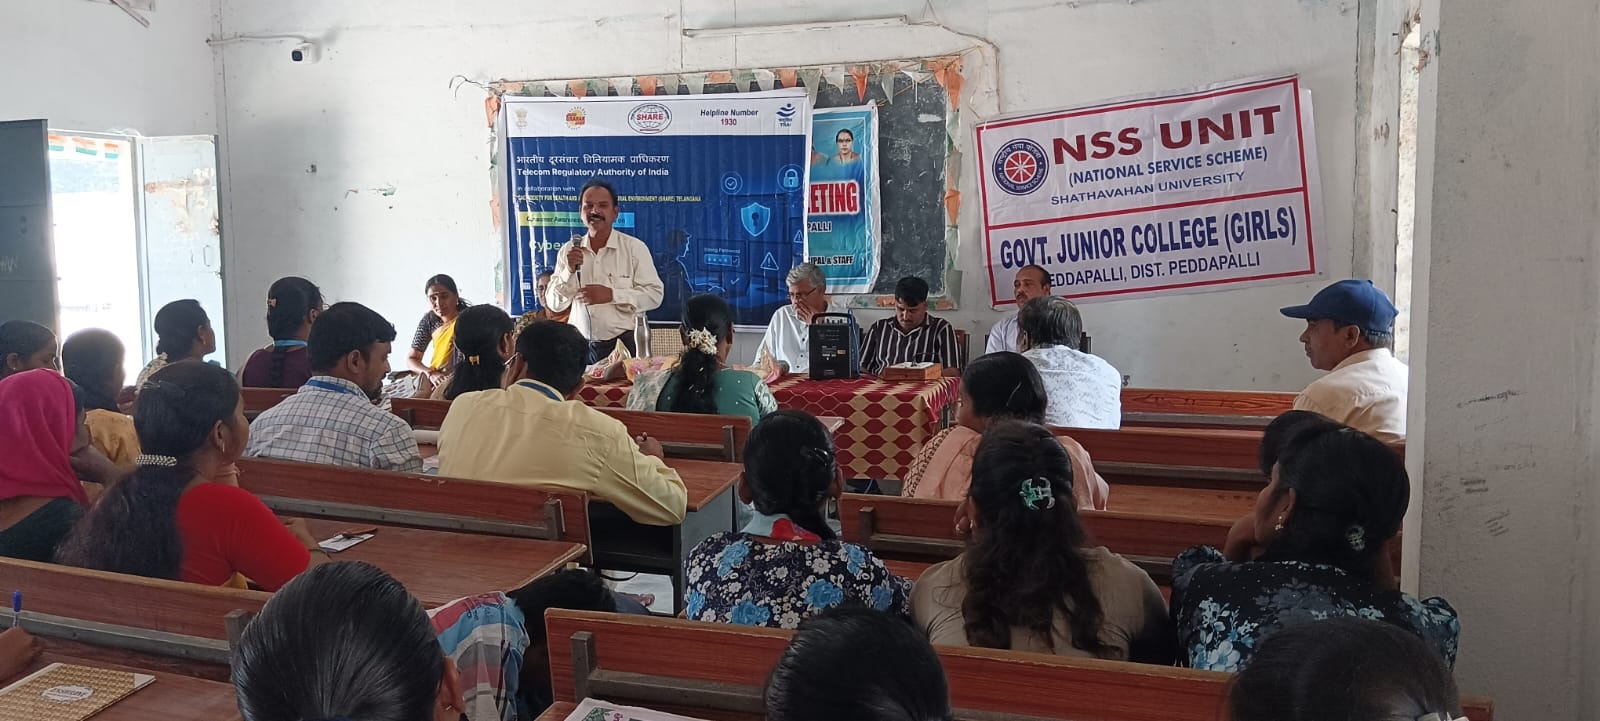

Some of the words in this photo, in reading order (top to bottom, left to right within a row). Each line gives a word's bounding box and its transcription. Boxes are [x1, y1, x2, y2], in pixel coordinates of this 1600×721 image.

[636, 113, 664, 121] SHARE
[700, 109, 729, 118] Helpline
[731, 108, 759, 116] Number
[720, 118, 737, 126] 1930
[1053, 127, 1143, 164] NSS
[1160, 105, 1280, 149] UNIT
[516, 154, 545, 164] भारतीय
[548, 152, 579, 166] दूरसंचार
[630, 153, 669, 164] प्राधिकरण
[1069, 163, 1144, 187] (NATIONAL
[1148, 156, 1202, 175] SERVICE
[1206, 146, 1268, 167] SCHEME)
[517, 168, 550, 176] Telecom
[552, 168, 595, 177] Regulatory
[598, 167, 635, 177] Authority
[637, 167, 646, 176] of
[648, 167, 669, 176] India
[808, 182, 857, 214] ETING
[1051, 183, 1154, 206] SHATHAVAHAN
[1158, 172, 1245, 192] UNIVERSITY
[1000, 237, 1051, 269] GOVT.
[1057, 227, 1125, 263] JUNIOR
[1131, 216, 1218, 255] COLLEGE
[1225, 206, 1296, 252] (GIRLS)
[808, 256, 826, 265] IPAL
[832, 255, 854, 265] STAFF
[1050, 266, 1127, 288] EDDAPALLI,
[1131, 262, 1165, 280] DIST.
[1169, 252, 1260, 276] PEDDAPALLI
